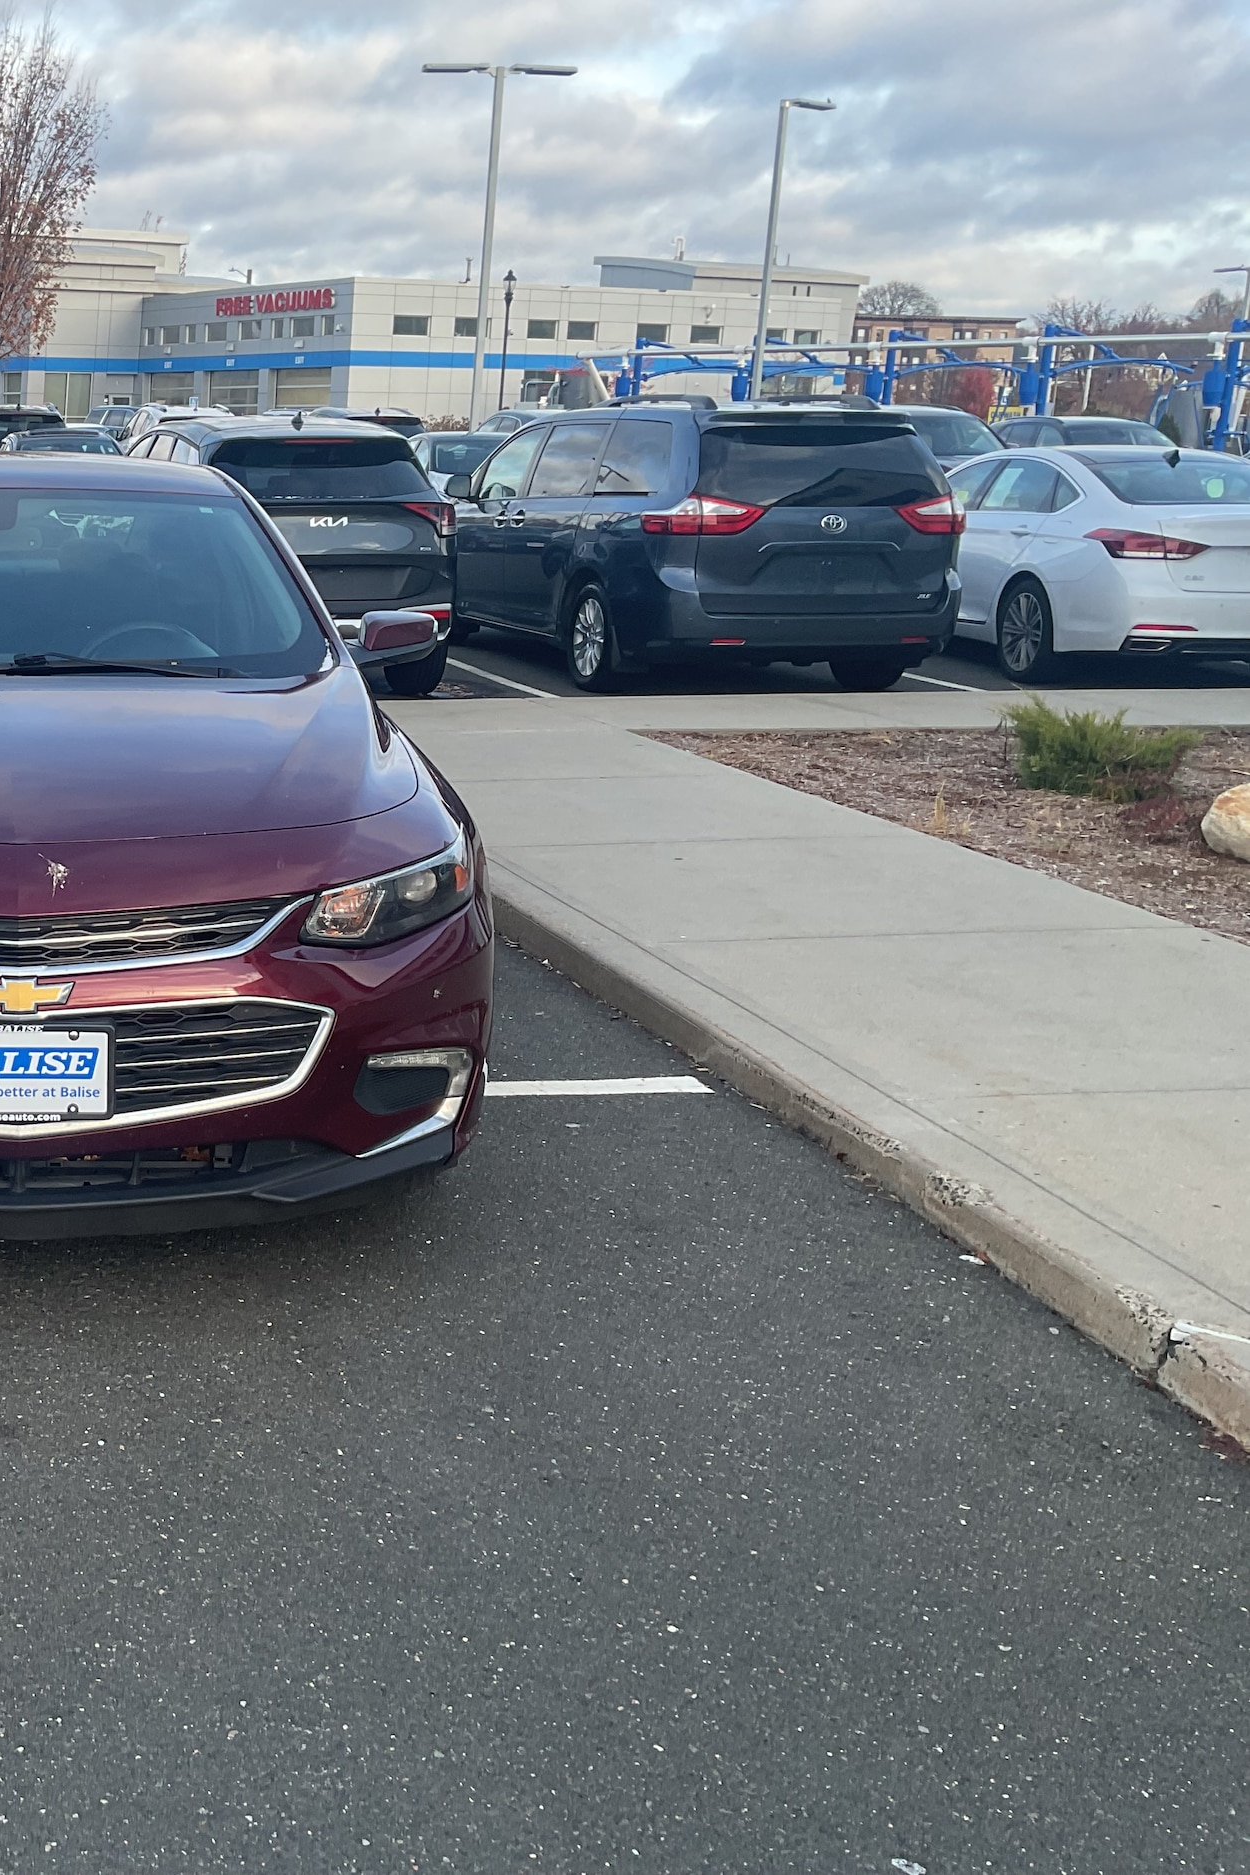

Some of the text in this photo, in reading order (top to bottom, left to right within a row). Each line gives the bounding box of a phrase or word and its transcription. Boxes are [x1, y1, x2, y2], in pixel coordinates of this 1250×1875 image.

[216, 288, 335, 316] FREE VACUUMS
[42, 1088, 56, 1098] at
[61, 1087, 100, 1098] Balise
